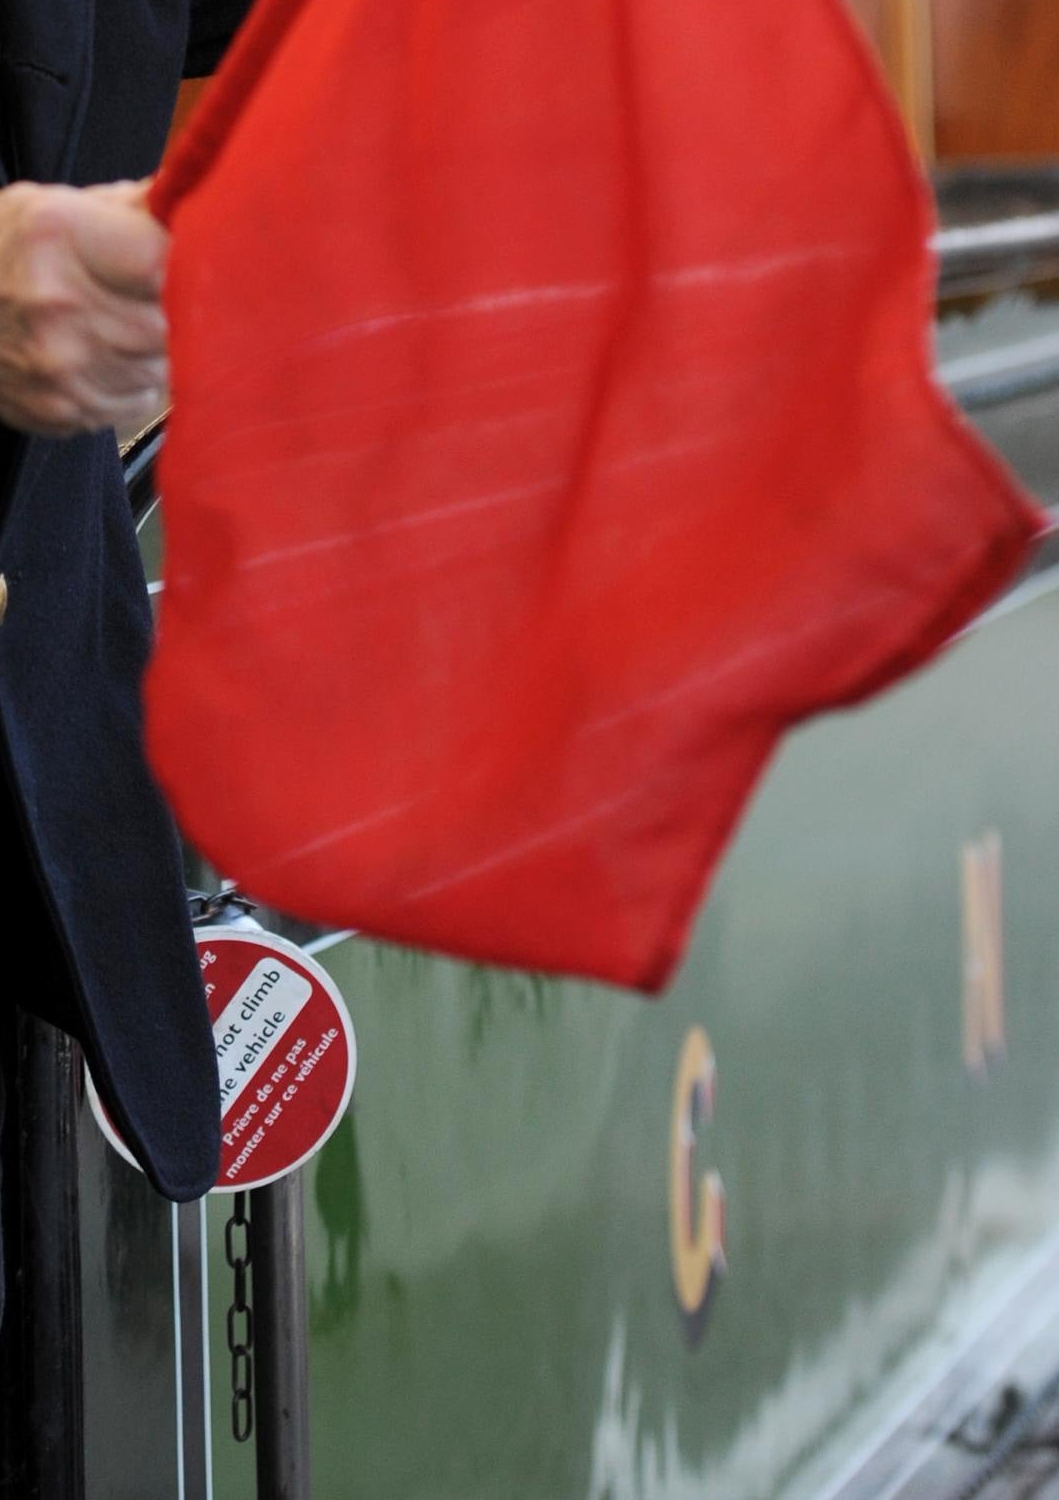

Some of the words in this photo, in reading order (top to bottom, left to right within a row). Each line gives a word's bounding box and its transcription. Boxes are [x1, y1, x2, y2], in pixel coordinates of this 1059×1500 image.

[216, 1024, 242, 1058] not
[240, 968, 281, 1021] climb
[235, 1009, 286, 1073] vehicle
[222, 1104, 259, 1146] Prière
[256, 1083, 274, 1102] de
[271, 1064, 289, 1083] ne
[285, 1037, 307, 1066] pas
[225, 1126, 266, 1179] monter
[263, 1101, 284, 1126] sur
[282, 1084, 298, 1102] ce
[295, 1026, 339, 1082] véhicule
